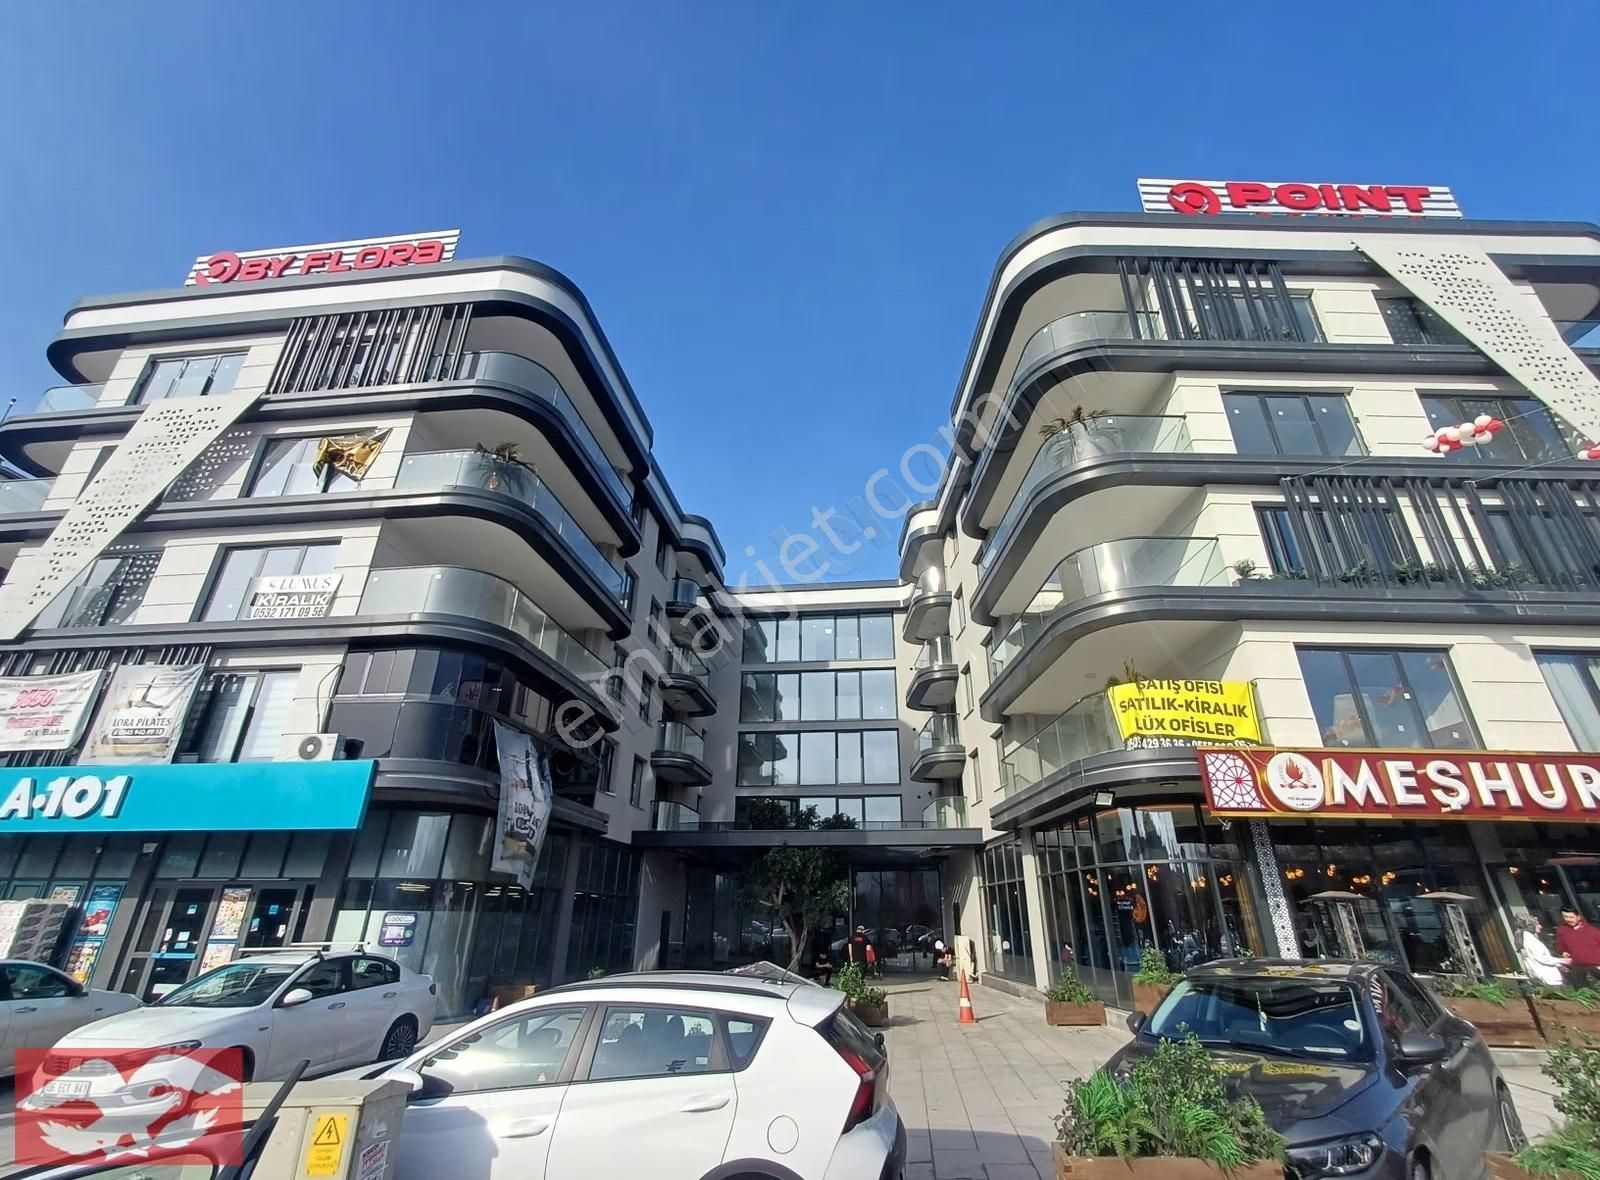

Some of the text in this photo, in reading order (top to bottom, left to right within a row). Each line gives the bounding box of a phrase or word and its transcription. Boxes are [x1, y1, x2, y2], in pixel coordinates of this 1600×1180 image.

[1226, 182, 1430, 213] POINT
[239, 240, 446, 282] BY FLORA
[253, 607, 277, 618] 0532
[279, 607, 296, 618] 171
[298, 607, 311, 617] 09
[1119, 696, 1249, 718] SATILIK-KİRALIK
[1135, 715, 1237, 737] LÜX OFİSLER
[1325, 756, 1600, 812] MEŞHUR
